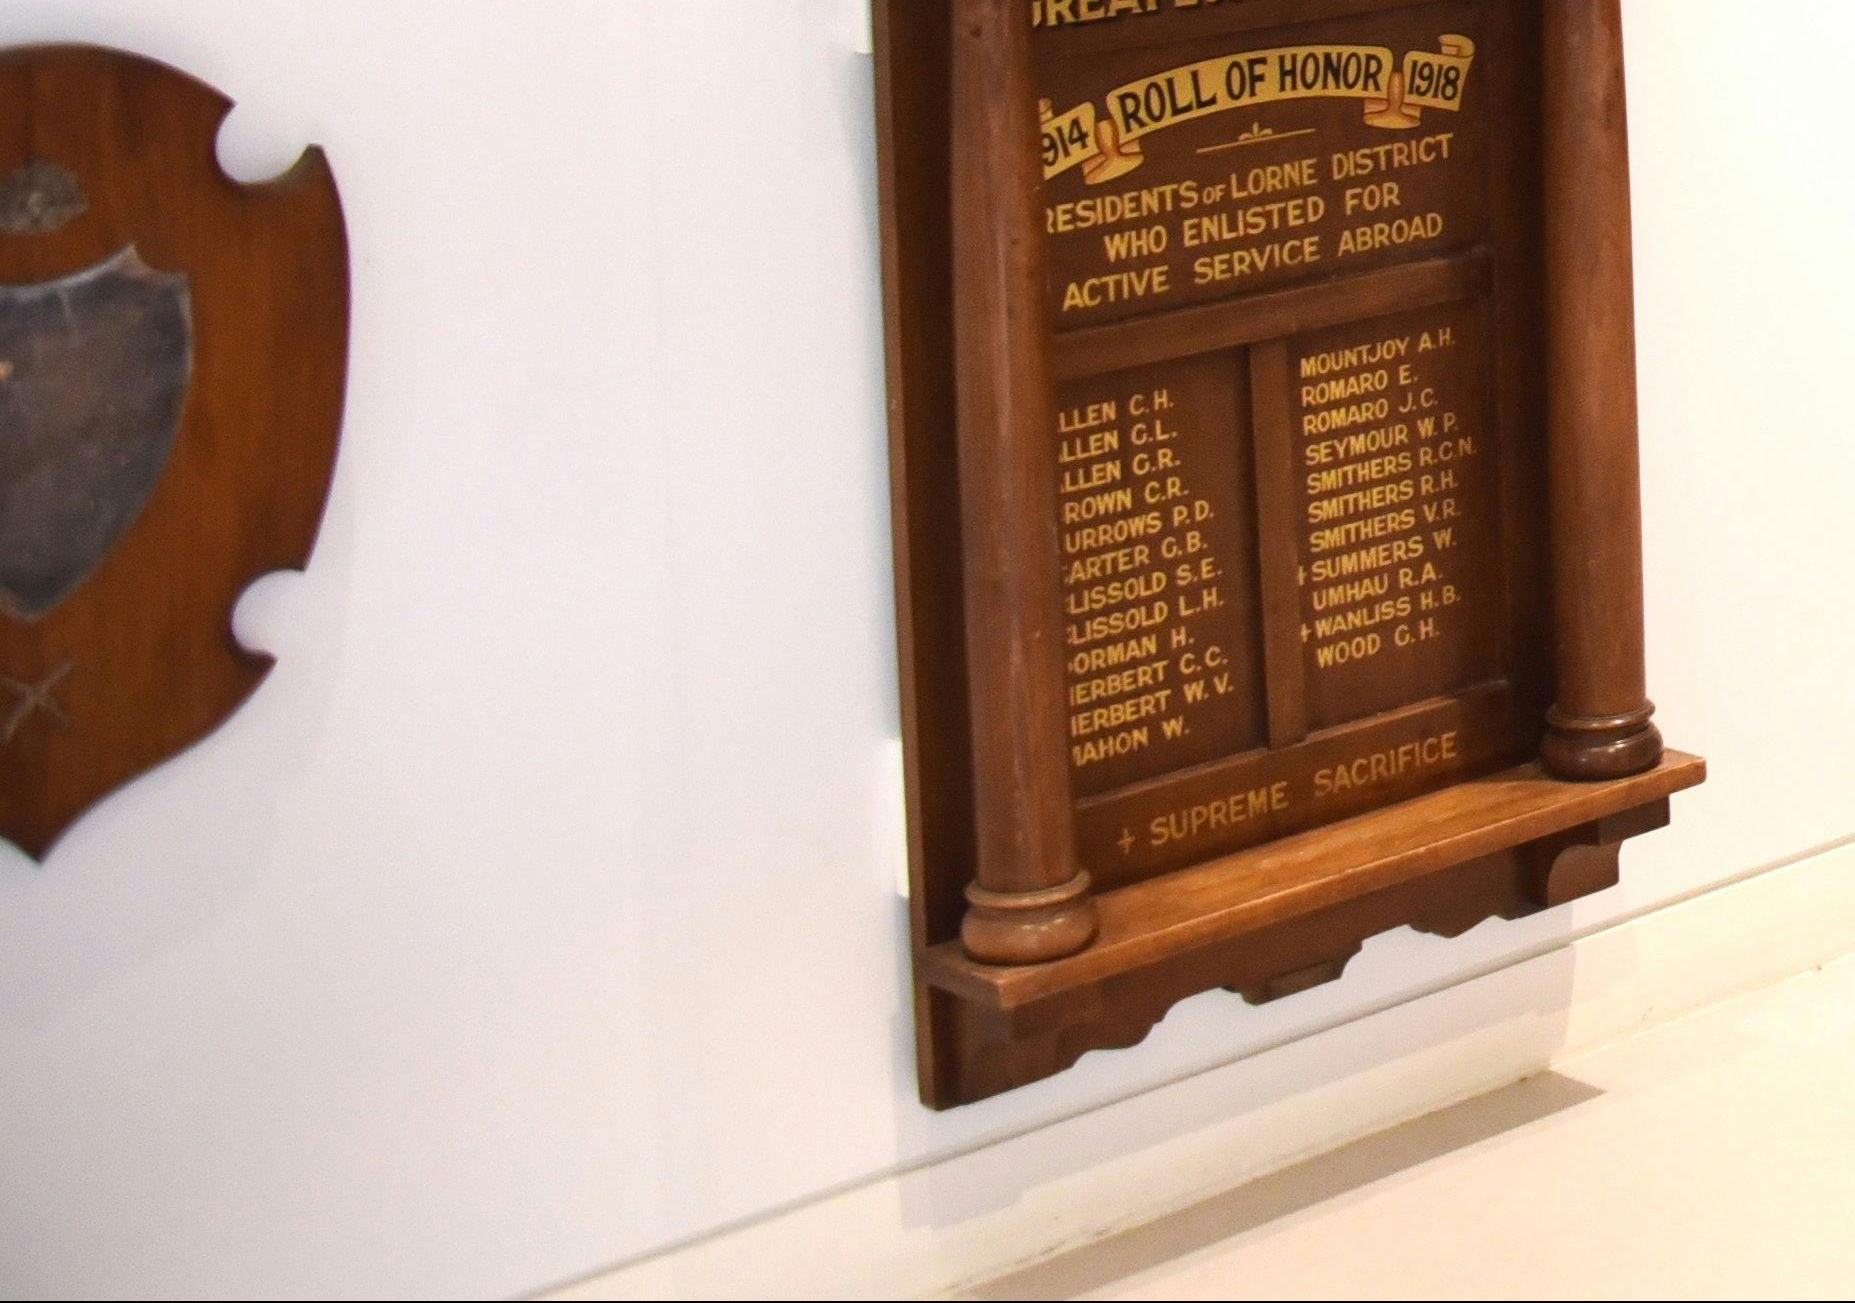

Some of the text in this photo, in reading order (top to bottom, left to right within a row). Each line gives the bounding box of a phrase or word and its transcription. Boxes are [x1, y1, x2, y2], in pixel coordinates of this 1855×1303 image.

[1042, 51, 1461, 167] 914 ROLL OF HONOR 1918
[1203, 183, 1225, 205] OF
[1231, 158, 1317, 199] LORNE
[1333, 133, 1454, 179] DISTRICT
[1103, 181, 1402, 263] WHO ENLISTED FOR
[1063, 212, 1443, 312] ACTIVE SERVICE ABROAD
[1300, 336, 1409, 378] MOUNTJOY
[1301, 370, 1388, 407] ROMARO
[1059, 401, 1117, 433] LLEN
[1303, 398, 1389, 436] ROMARO
[1305, 424, 1409, 467] SEYMOUR
[1306, 452, 1413, 495] SMITHERS
[1308, 480, 1414, 524] SMITHERS
[1310, 508, 1416, 553] SMITHERS
[1311, 536, 1424, 582] SUMMERS
[1312, 573, 1388, 611] UMHAU
[1315, 596, 1411, 639] WANLISS
[1316, 632, 1381, 669] WOOD
[1149, 731, 1457, 847] SUPREME SACRIFICE
